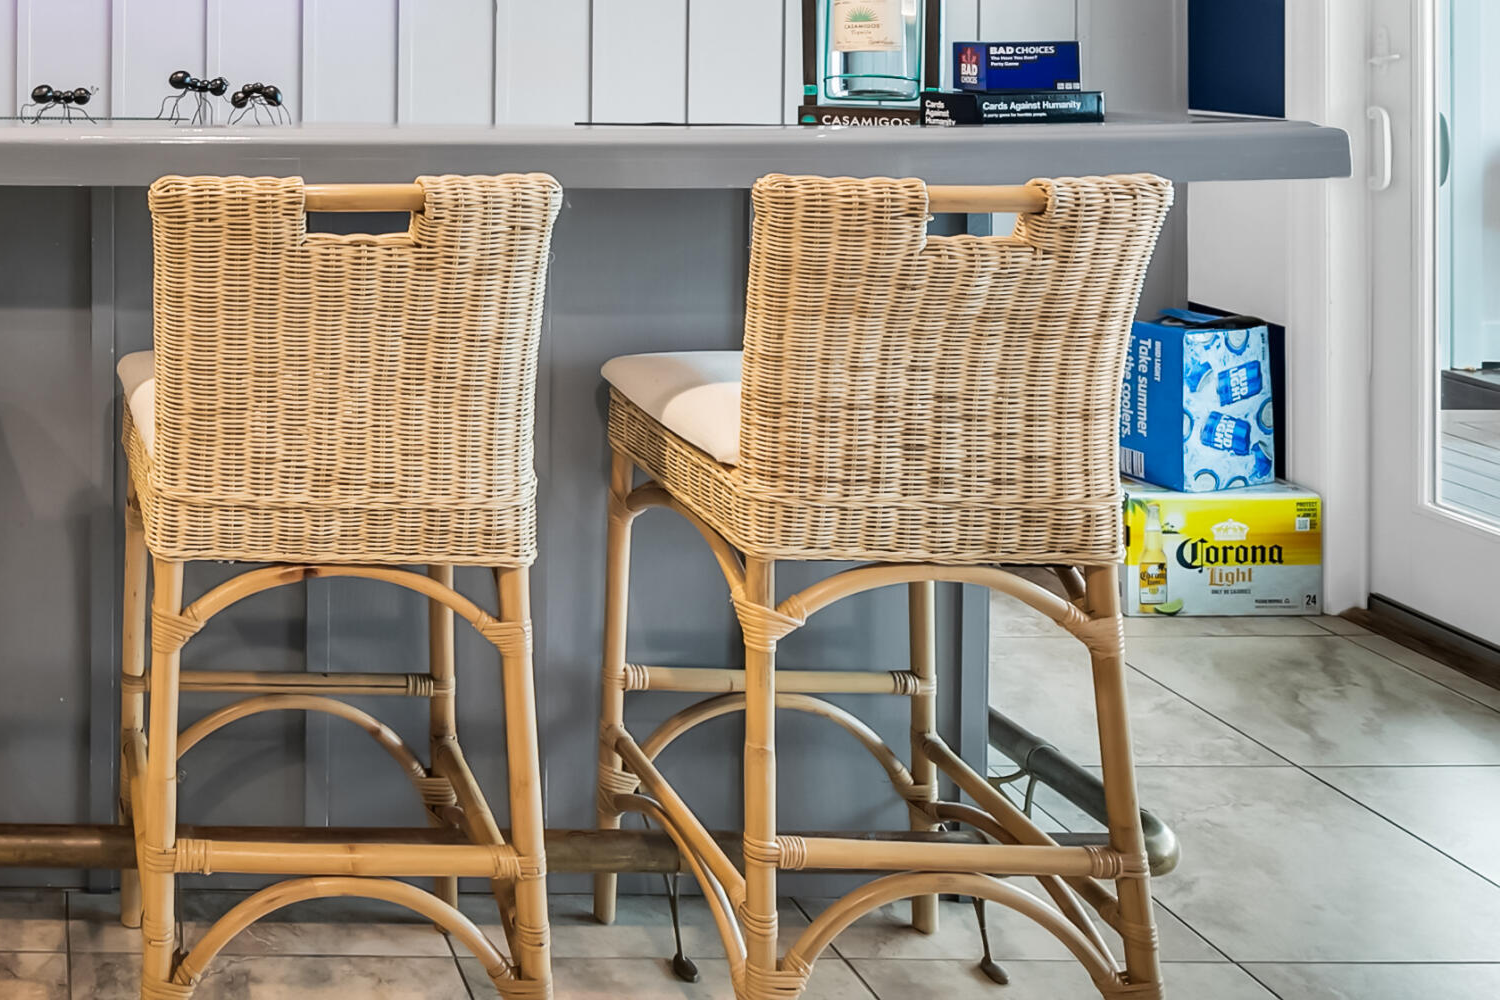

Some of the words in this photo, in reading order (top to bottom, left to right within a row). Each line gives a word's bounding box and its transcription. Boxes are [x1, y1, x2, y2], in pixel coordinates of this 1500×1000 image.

[989, 46, 1014, 55] BAD
[1015, 46, 1055, 54] CHOICES
[961, 63, 978, 76] BAD
[822, 115, 911, 125] CASAMIGOS
[983, 102, 1008, 110] Cards
[1010, 101, 1040, 111] Against
[1042, 101, 1081, 110] Humanity
[1125, 355, 1135, 380] the
[1138, 338, 1152, 373] Take
[1229, 367, 1241, 401] LIGHT
[1237, 367, 1248, 396] BUD
[1121, 382, 1134, 438] coolers.
[1137, 375, 1148, 437] summer
[1214, 415, 1231, 448] LIGHT
[1223, 419, 1236, 448] BUD
[1176, 537, 1284, 573] Corona
[1207, 567, 1252, 586] Light
[1306, 594, 1317, 606] 24
